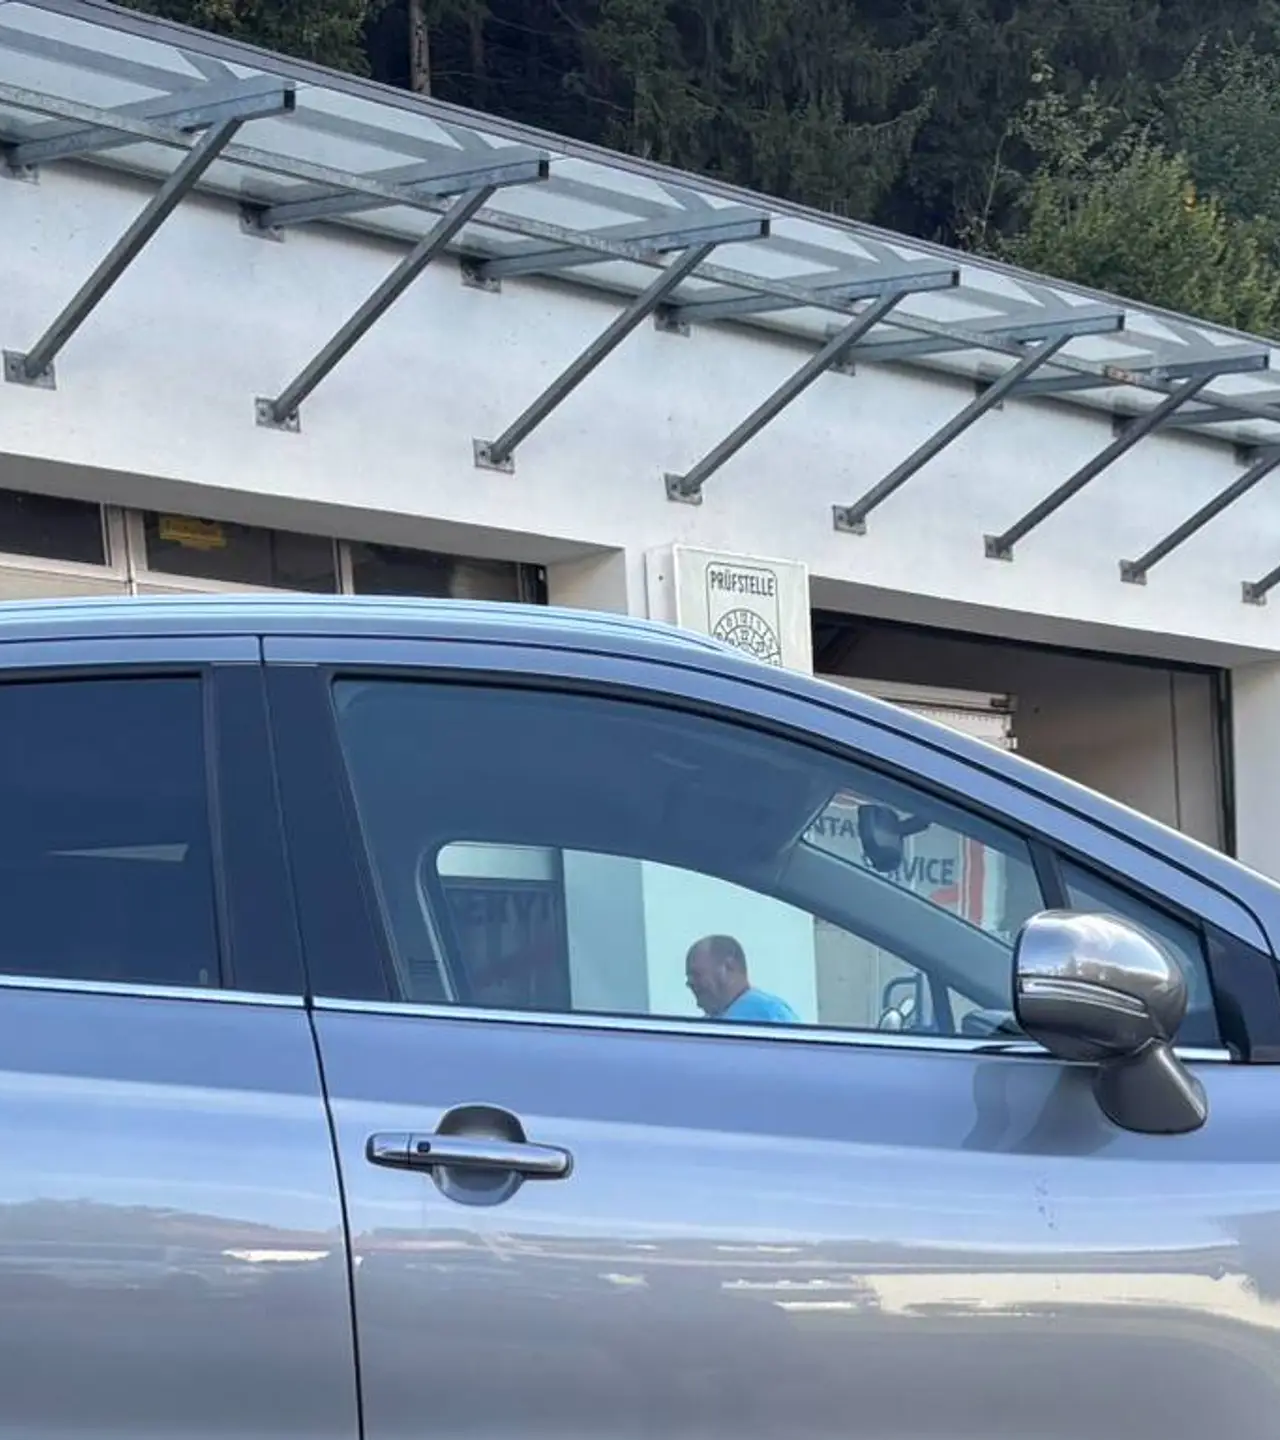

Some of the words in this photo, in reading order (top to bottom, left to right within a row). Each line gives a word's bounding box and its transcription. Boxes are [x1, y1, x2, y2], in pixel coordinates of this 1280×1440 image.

[709, 568, 775, 598] PRÜFSTELLE
[812, 815, 856, 839] NTA
[888, 857, 956, 886] VICE
